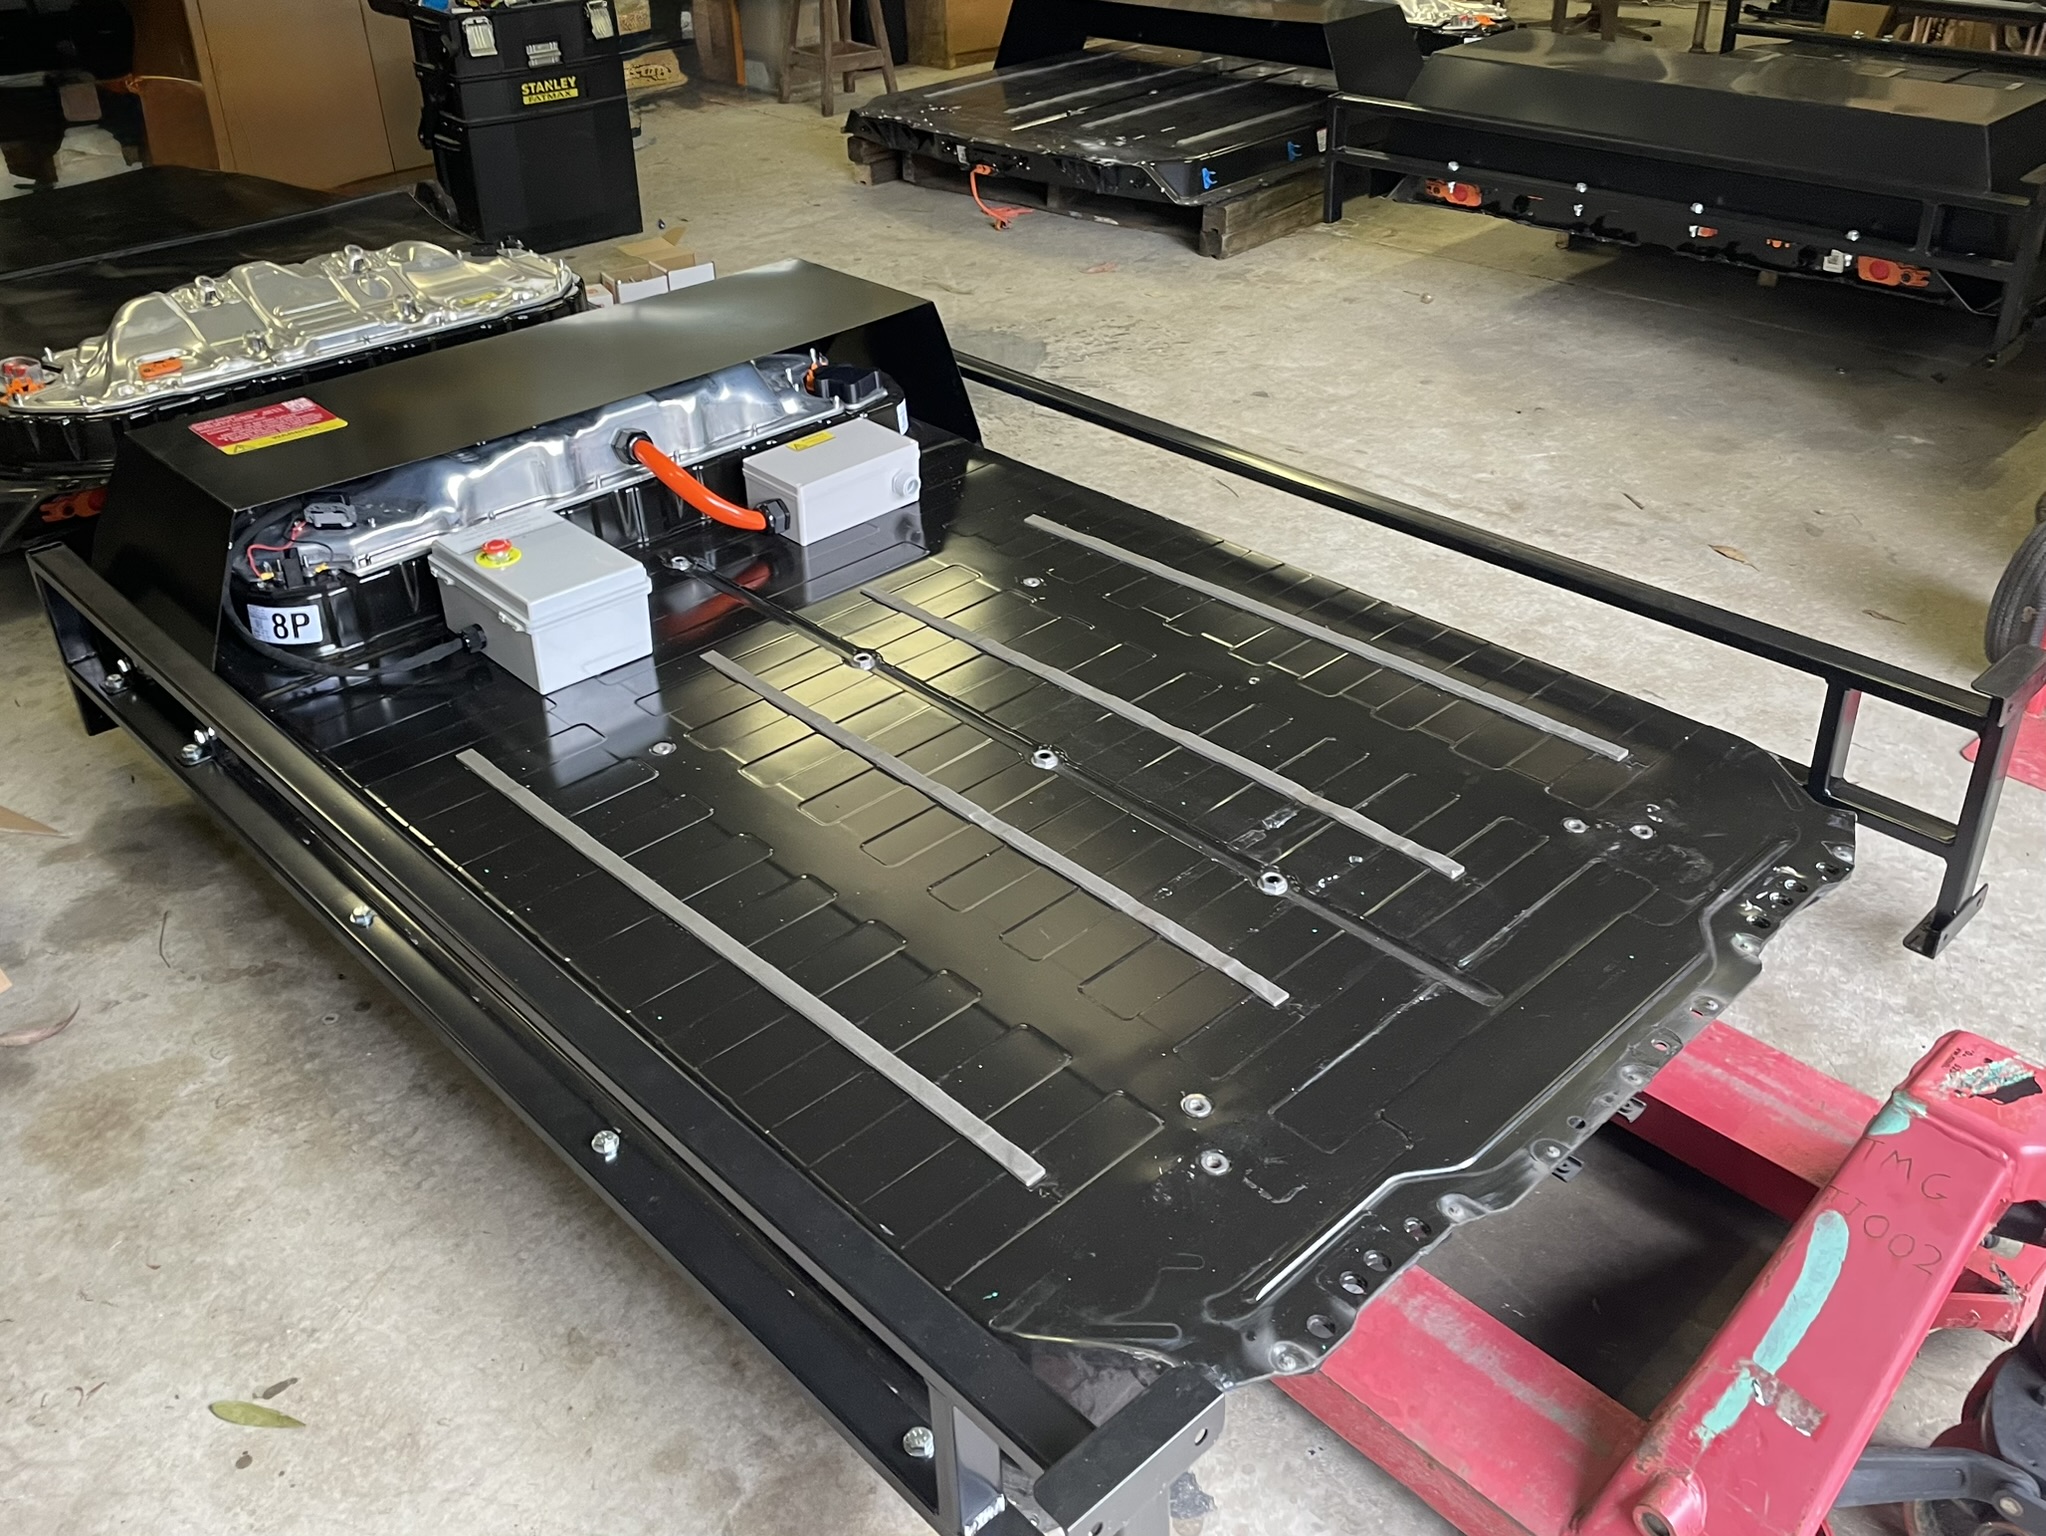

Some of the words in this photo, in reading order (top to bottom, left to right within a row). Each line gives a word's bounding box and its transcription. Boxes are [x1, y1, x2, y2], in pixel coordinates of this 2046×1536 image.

[521, 75, 576, 95] STANLEY
[528, 90, 572, 102] FATMAX
[272, 612, 310, 640] 8P
